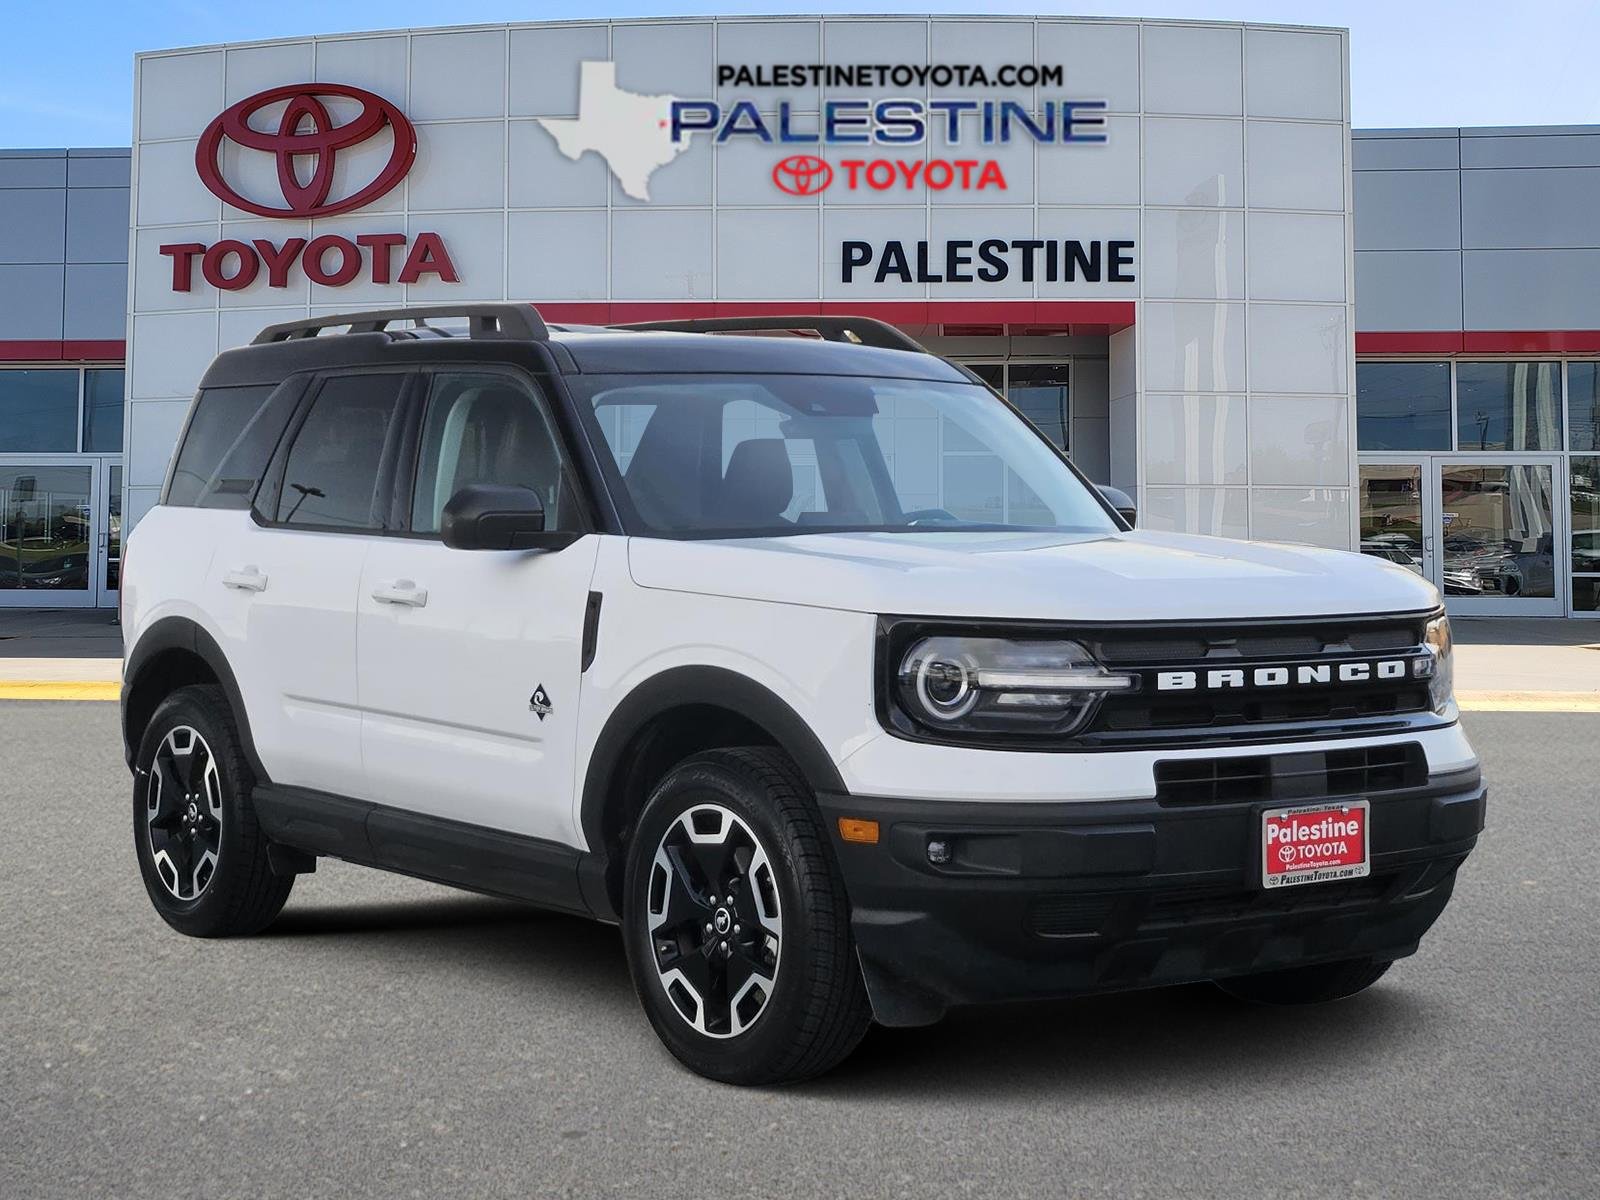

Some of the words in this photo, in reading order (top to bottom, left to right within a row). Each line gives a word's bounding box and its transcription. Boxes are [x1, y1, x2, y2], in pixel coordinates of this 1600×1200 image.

[160, 232, 460, 291] TOYOTA
[842, 240, 1135, 283] PALESTINE
[1157, 660, 1406, 690] BRONCO
[1267, 817, 1359, 845] Palestine
[1298, 841, 1348, 858] TOYOTA
[1285, 859, 1341, 871] PalestineToyota.com
